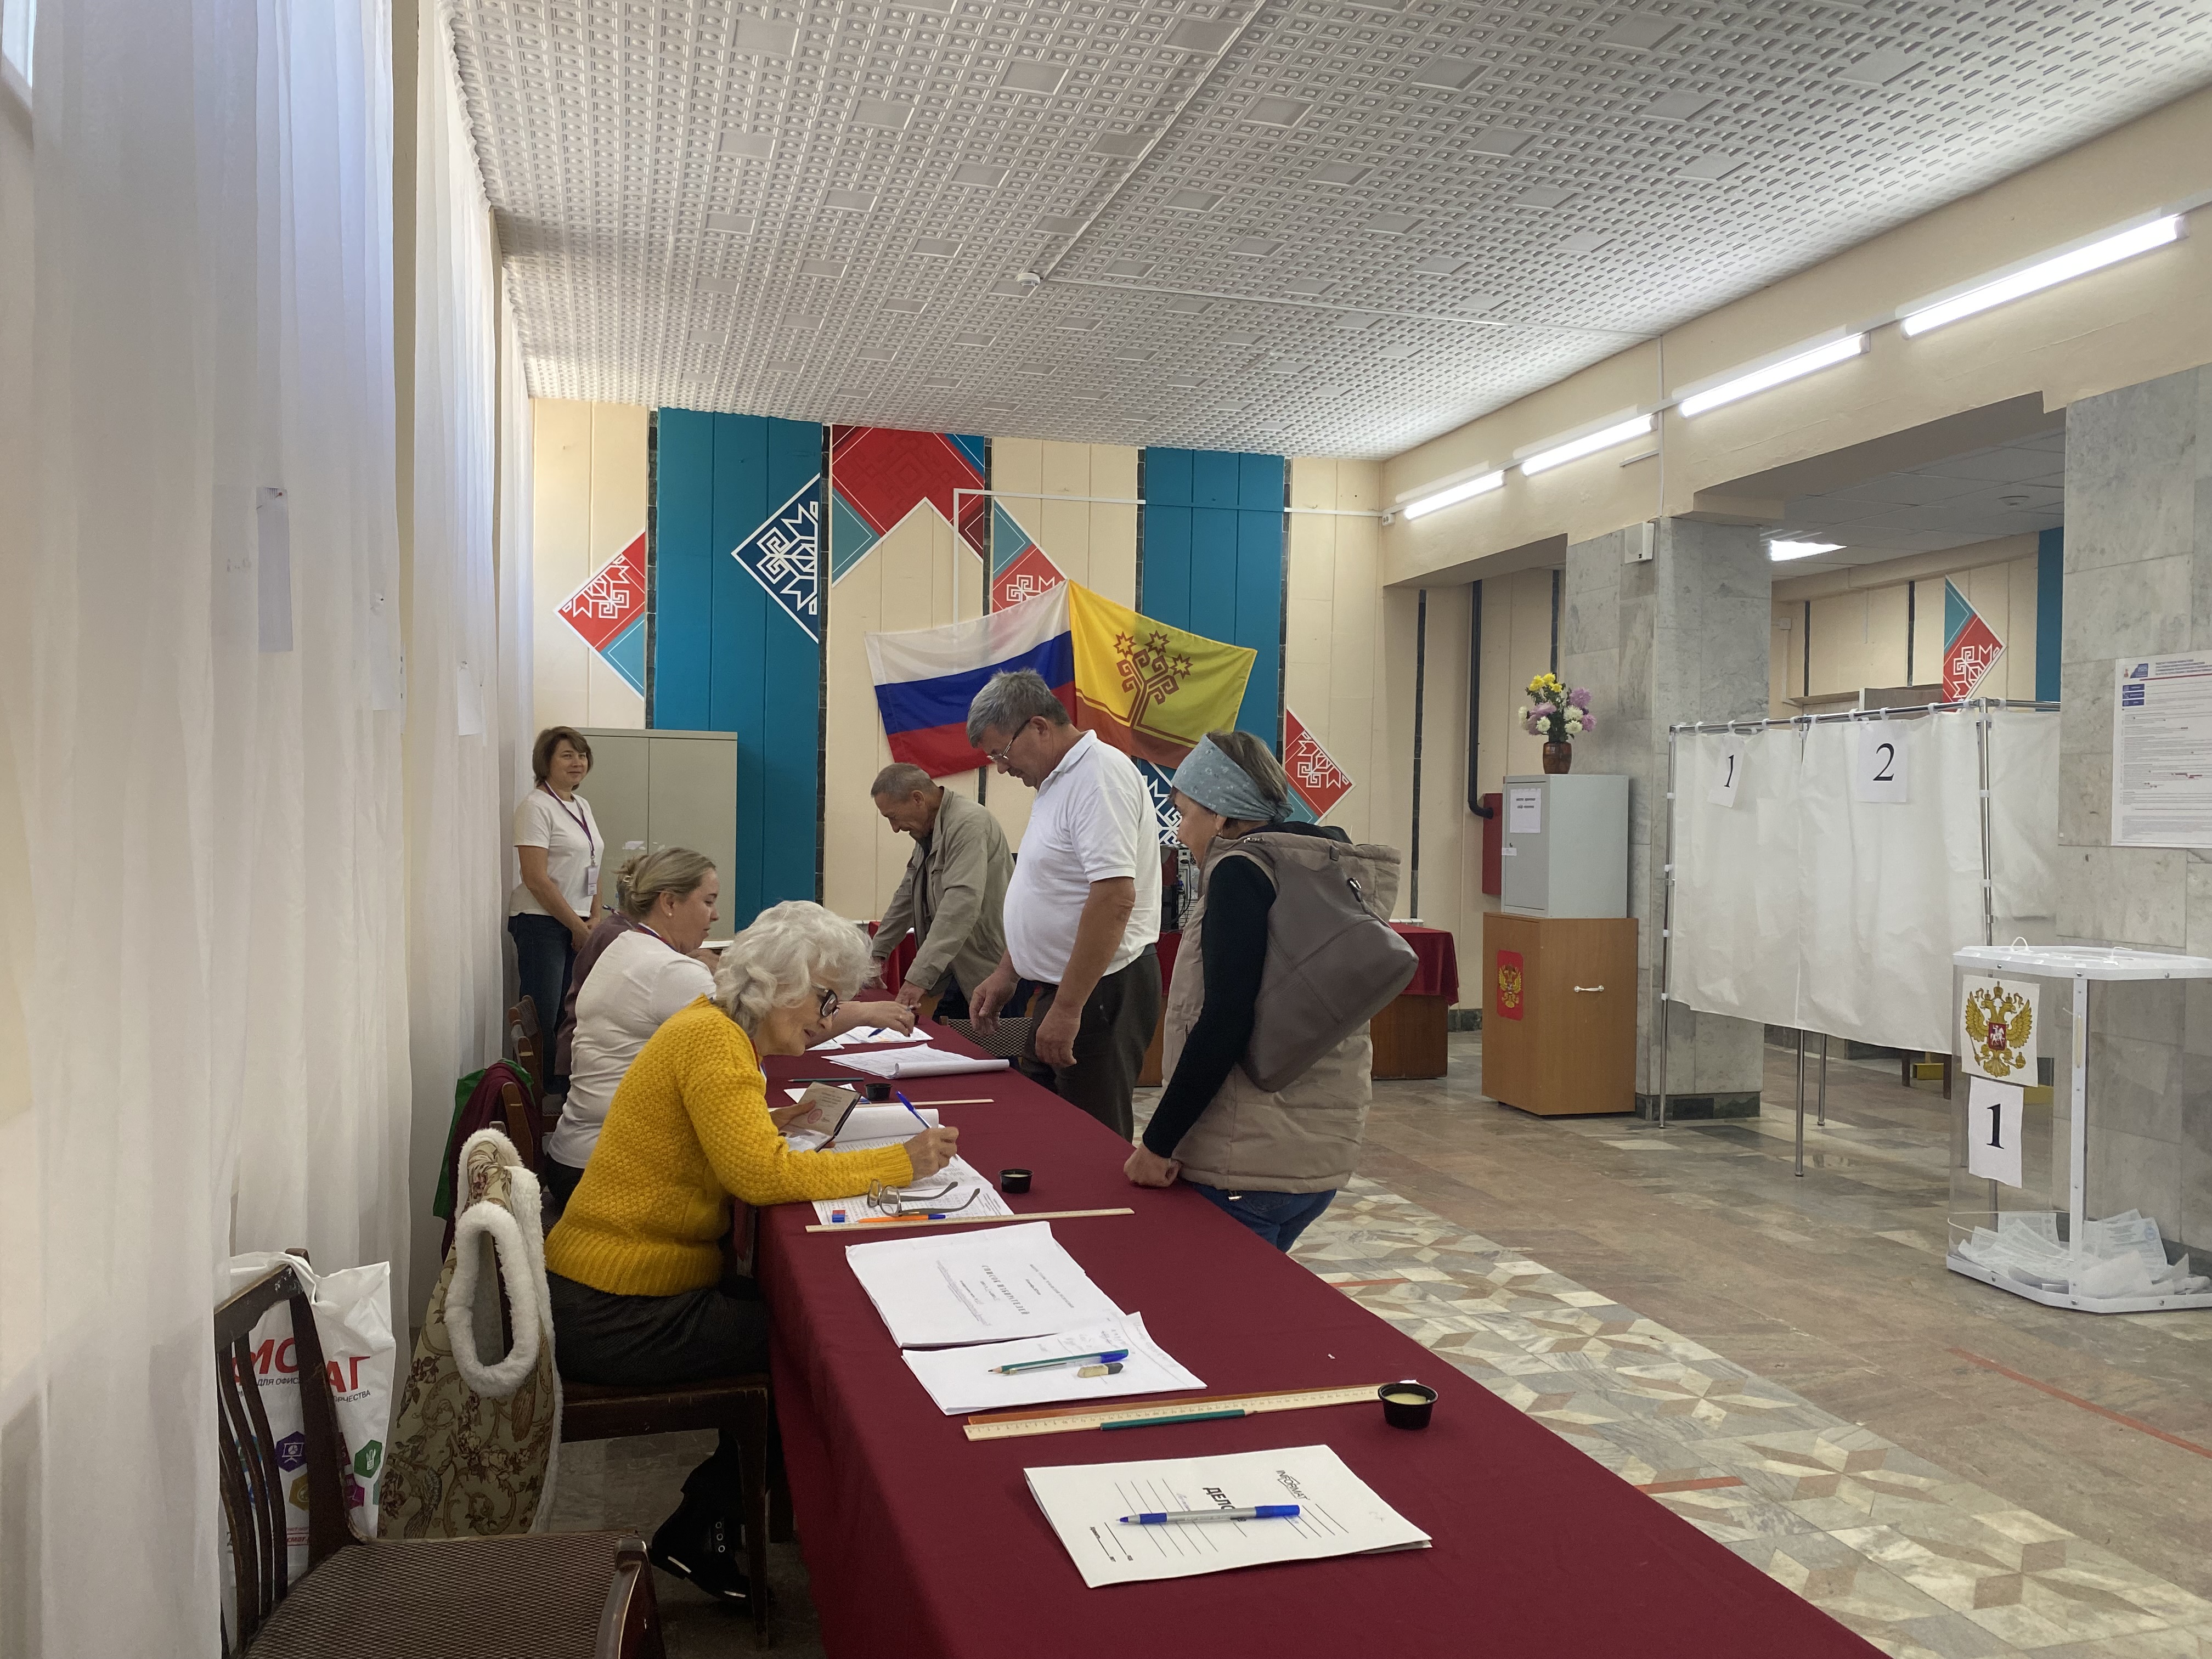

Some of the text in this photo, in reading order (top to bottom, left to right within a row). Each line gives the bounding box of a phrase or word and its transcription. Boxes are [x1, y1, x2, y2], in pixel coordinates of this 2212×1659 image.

[1724, 754, 1735, 788] 1
[1872, 742, 1895, 782] 2
[1986, 1103, 2005, 1150] 1
[257, 1377, 371, 1402] ДЛЯ ОФИС ОРЧЕСТВА
[1276, 1470, 1308, 1500] INFORMAT
